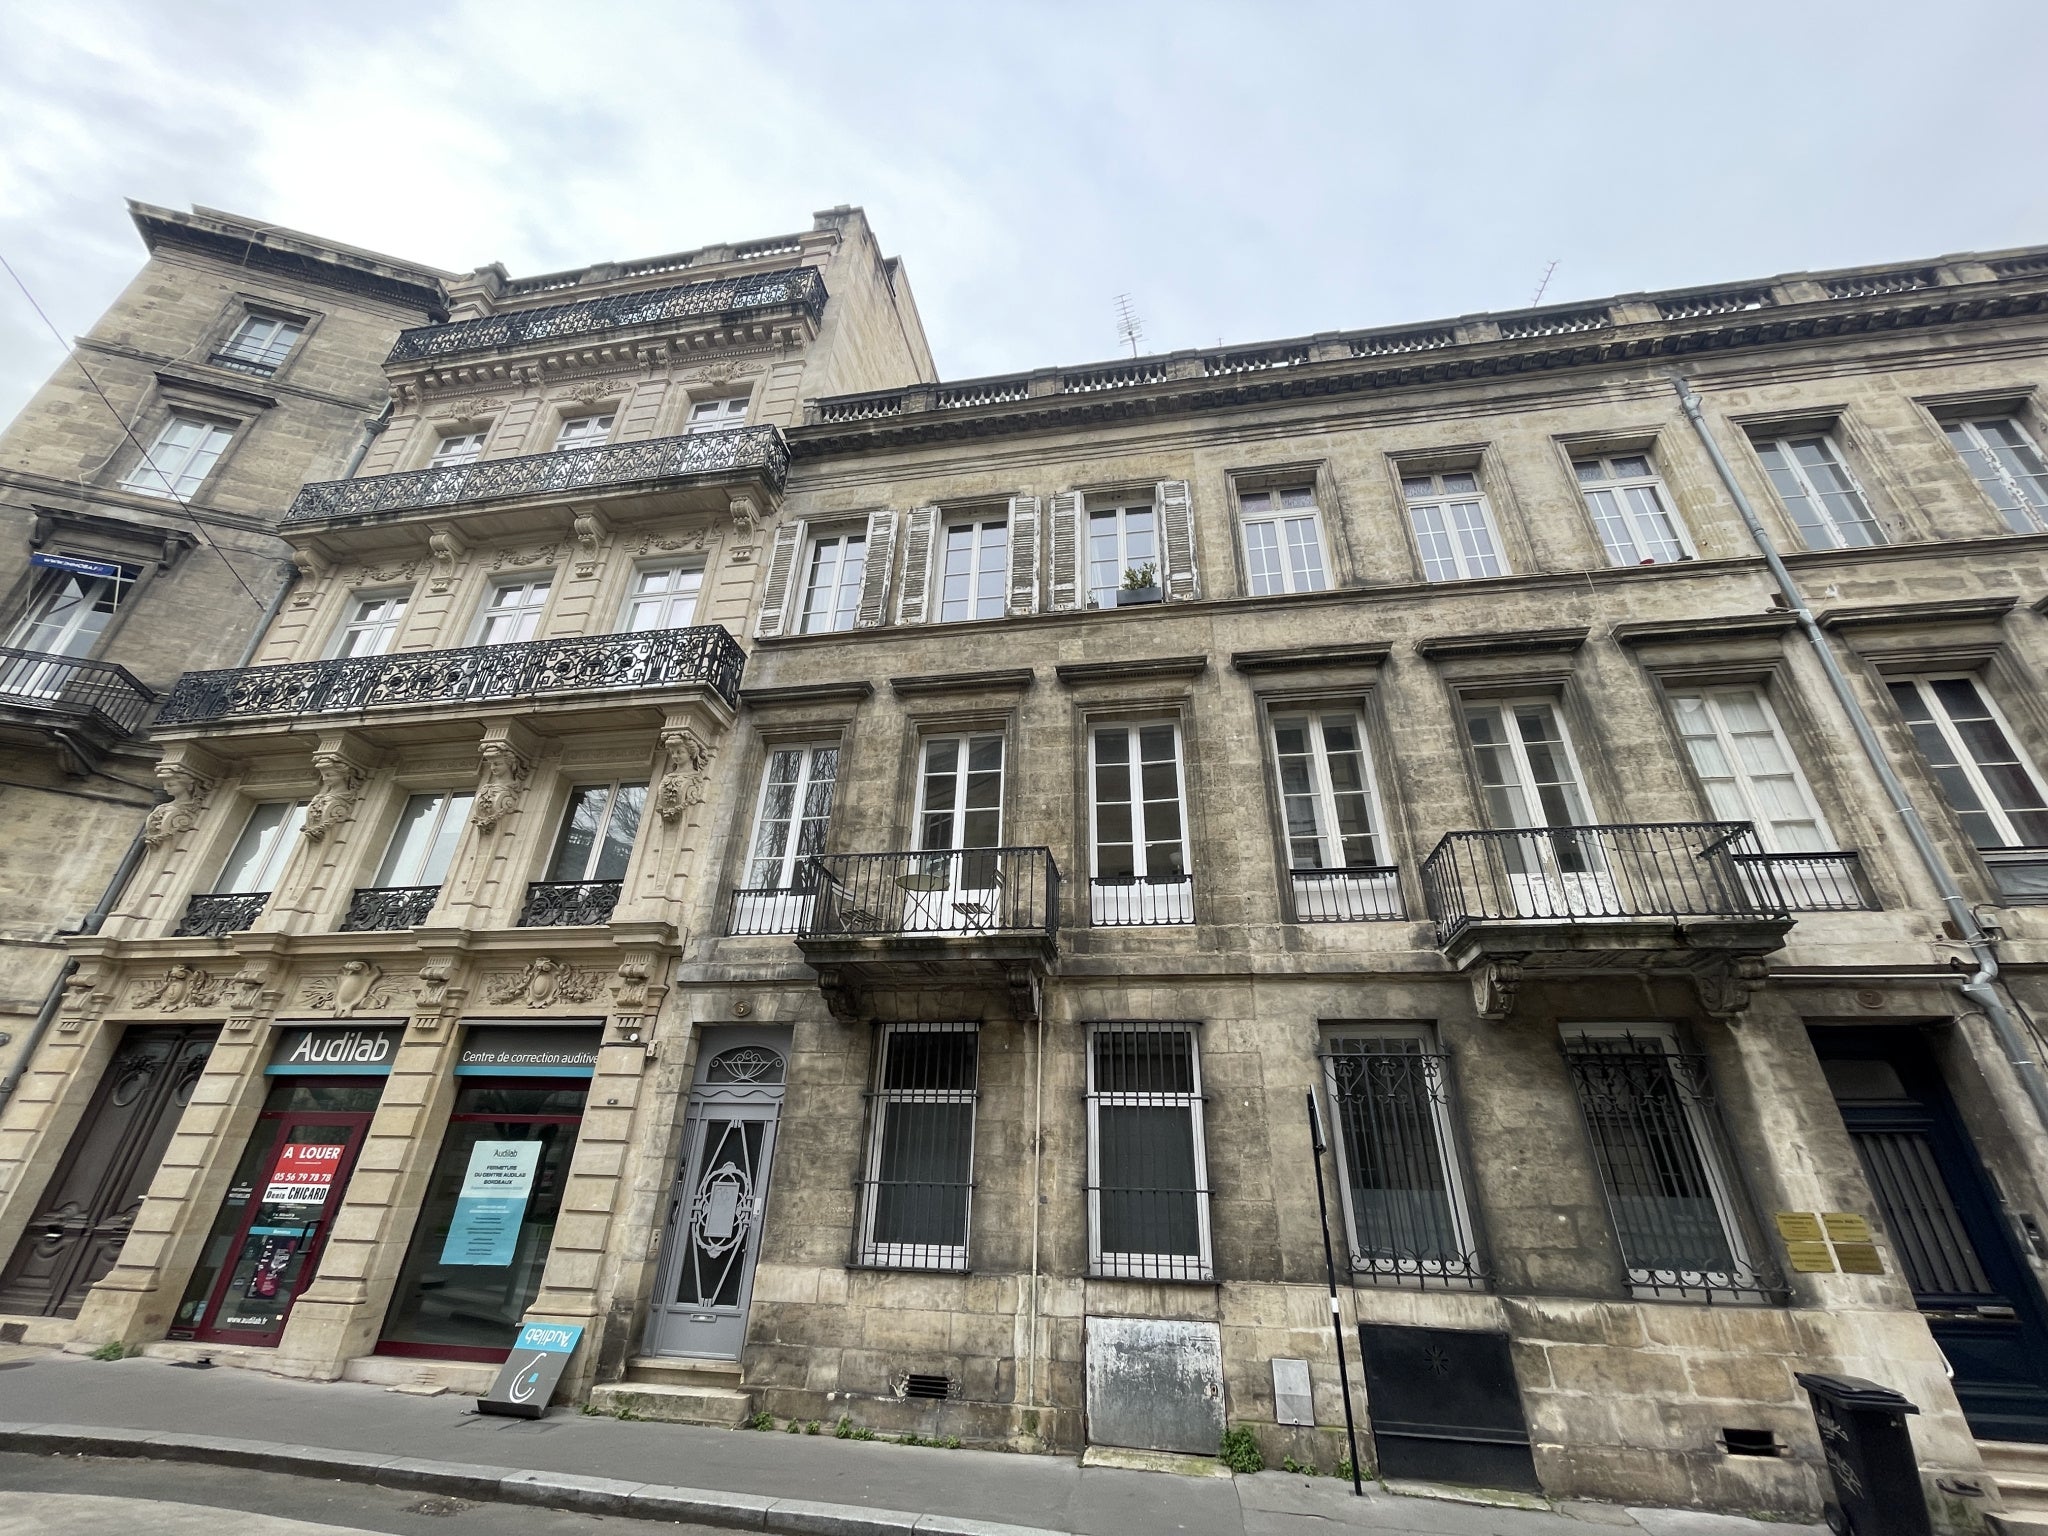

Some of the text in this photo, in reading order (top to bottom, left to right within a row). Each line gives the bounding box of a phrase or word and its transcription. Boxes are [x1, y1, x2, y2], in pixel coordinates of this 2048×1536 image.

[289, 1031, 390, 1062] Audilab
[462, 1050, 495, 1063] Centre
[496, 1051, 509, 1063] de
[510, 1051, 560, 1064] correction
[283, 1146, 341, 1160] A LOUER
[493, 1149, 518, 1158] Audilab
[274, 1172, 332, 1182] 05 56 79 78 78
[266, 1186, 328, 1201] Denis CHICARD
[525, 1328, 573, 1347] Audilab
